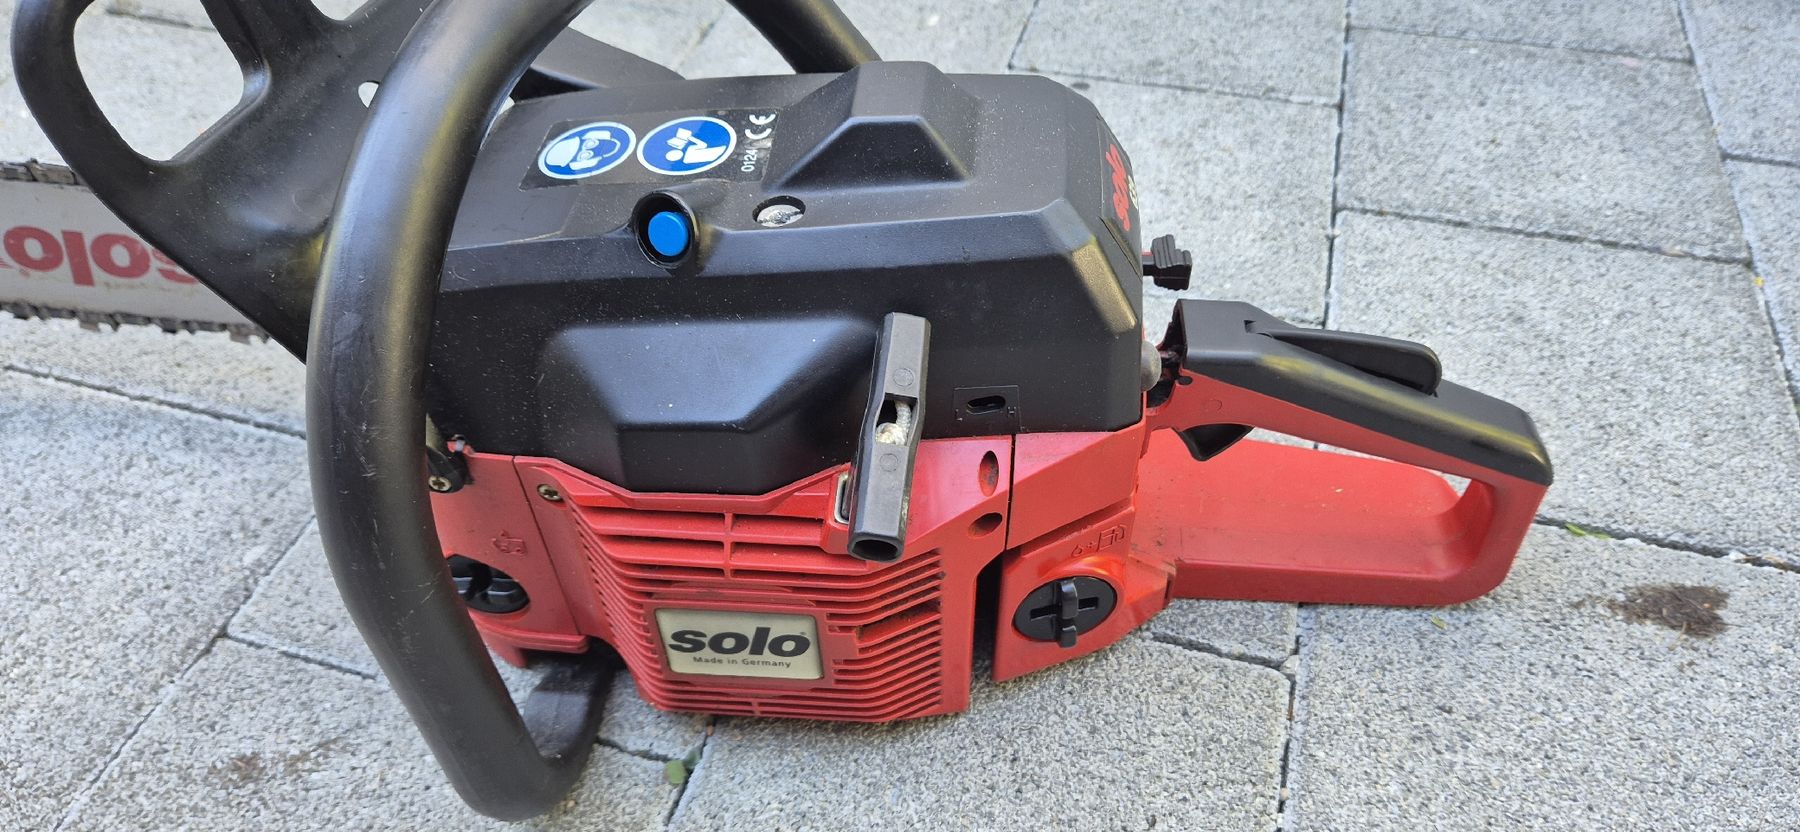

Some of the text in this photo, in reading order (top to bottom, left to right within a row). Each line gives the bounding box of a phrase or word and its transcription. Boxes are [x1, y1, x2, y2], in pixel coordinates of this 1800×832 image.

[741, 149, 758, 172] 0124
[668, 626, 811, 657] solo
[693, 656, 792, 668] Made in Germany
